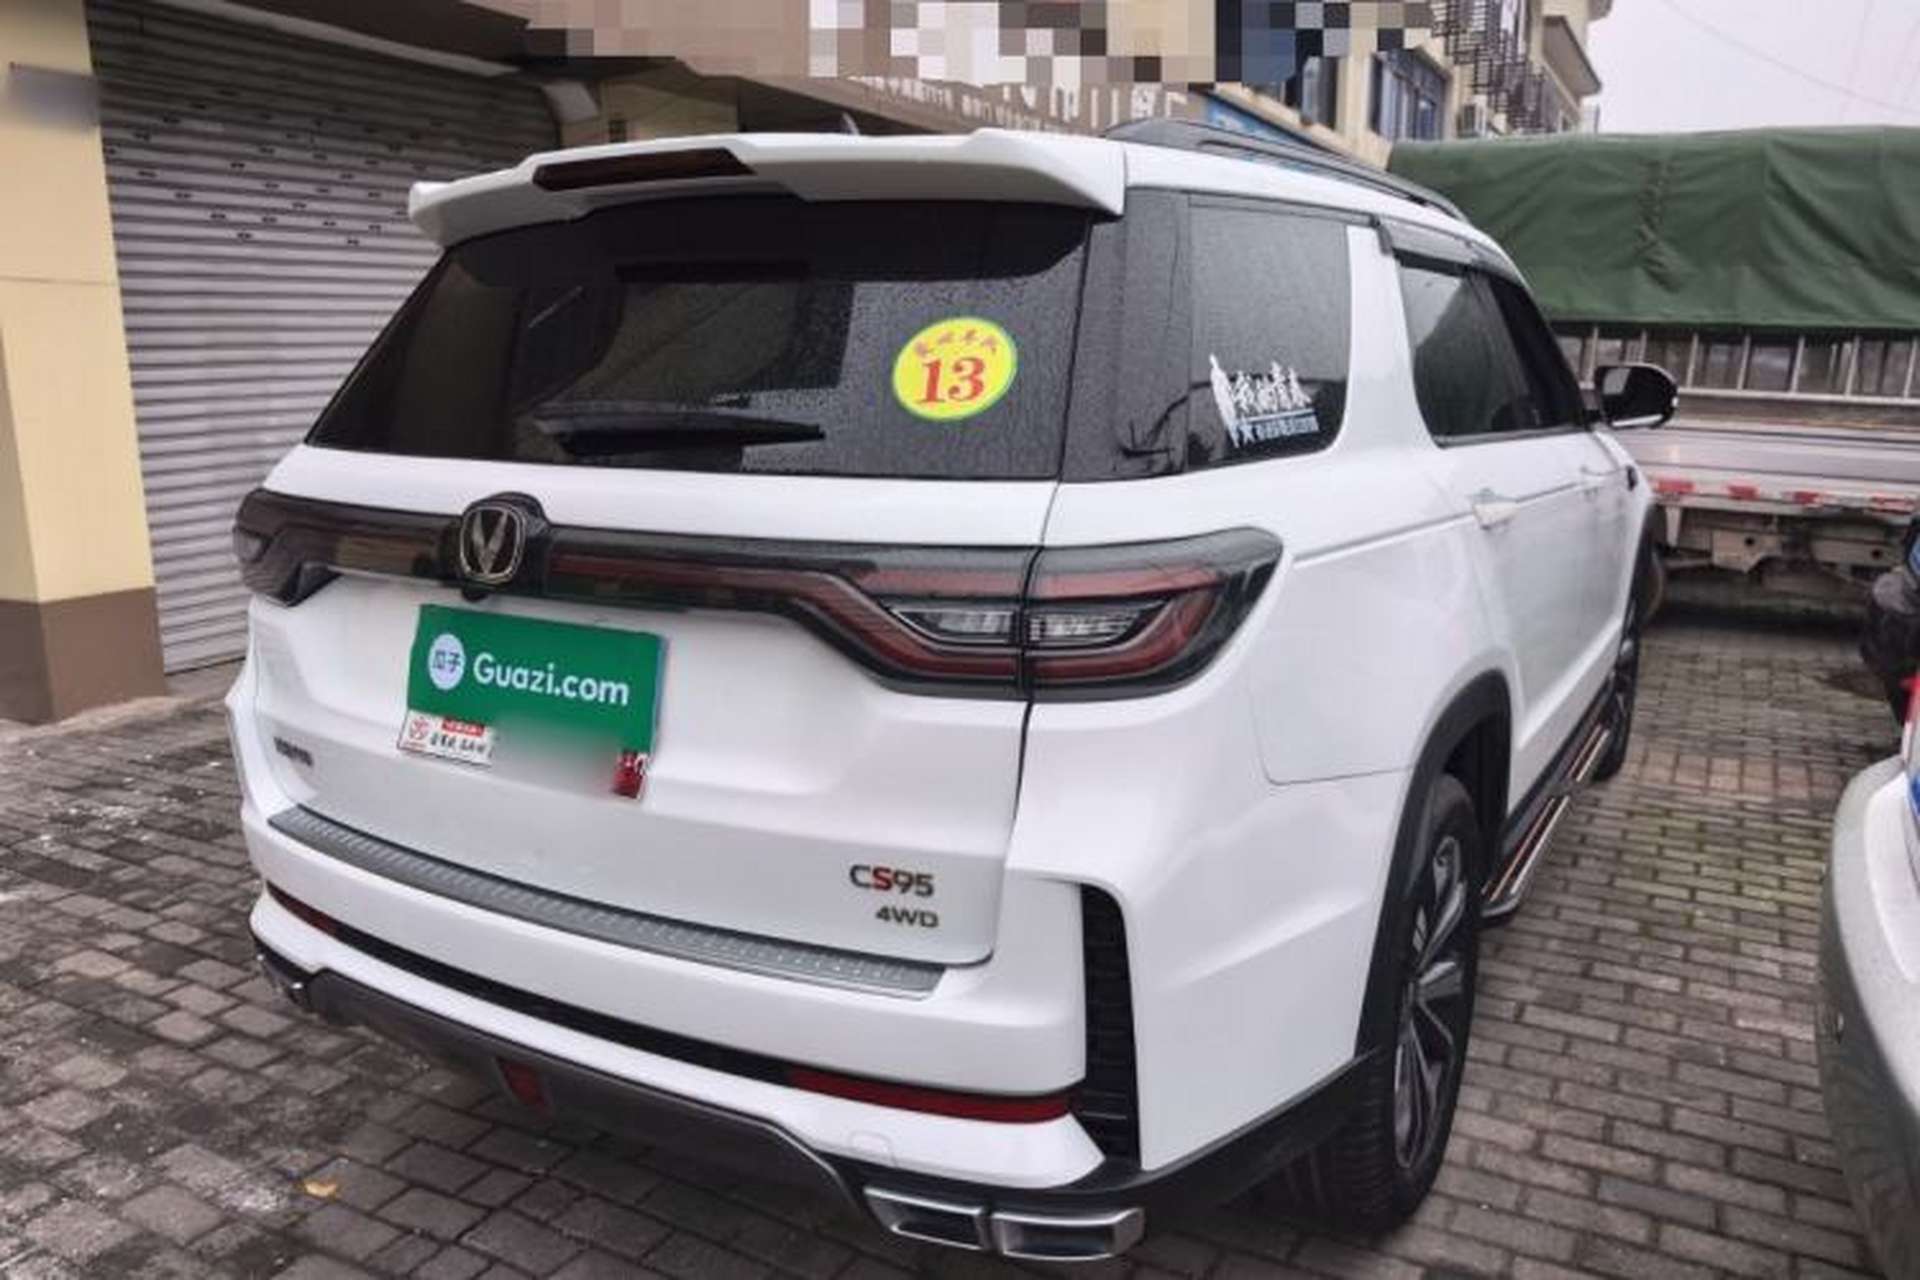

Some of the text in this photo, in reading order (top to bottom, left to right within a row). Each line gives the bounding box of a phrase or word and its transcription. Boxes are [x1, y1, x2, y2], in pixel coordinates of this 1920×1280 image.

[914, 358, 985, 405] 13
[849, 864, 934, 898] CS95
[876, 905, 939, 928] 4WD
